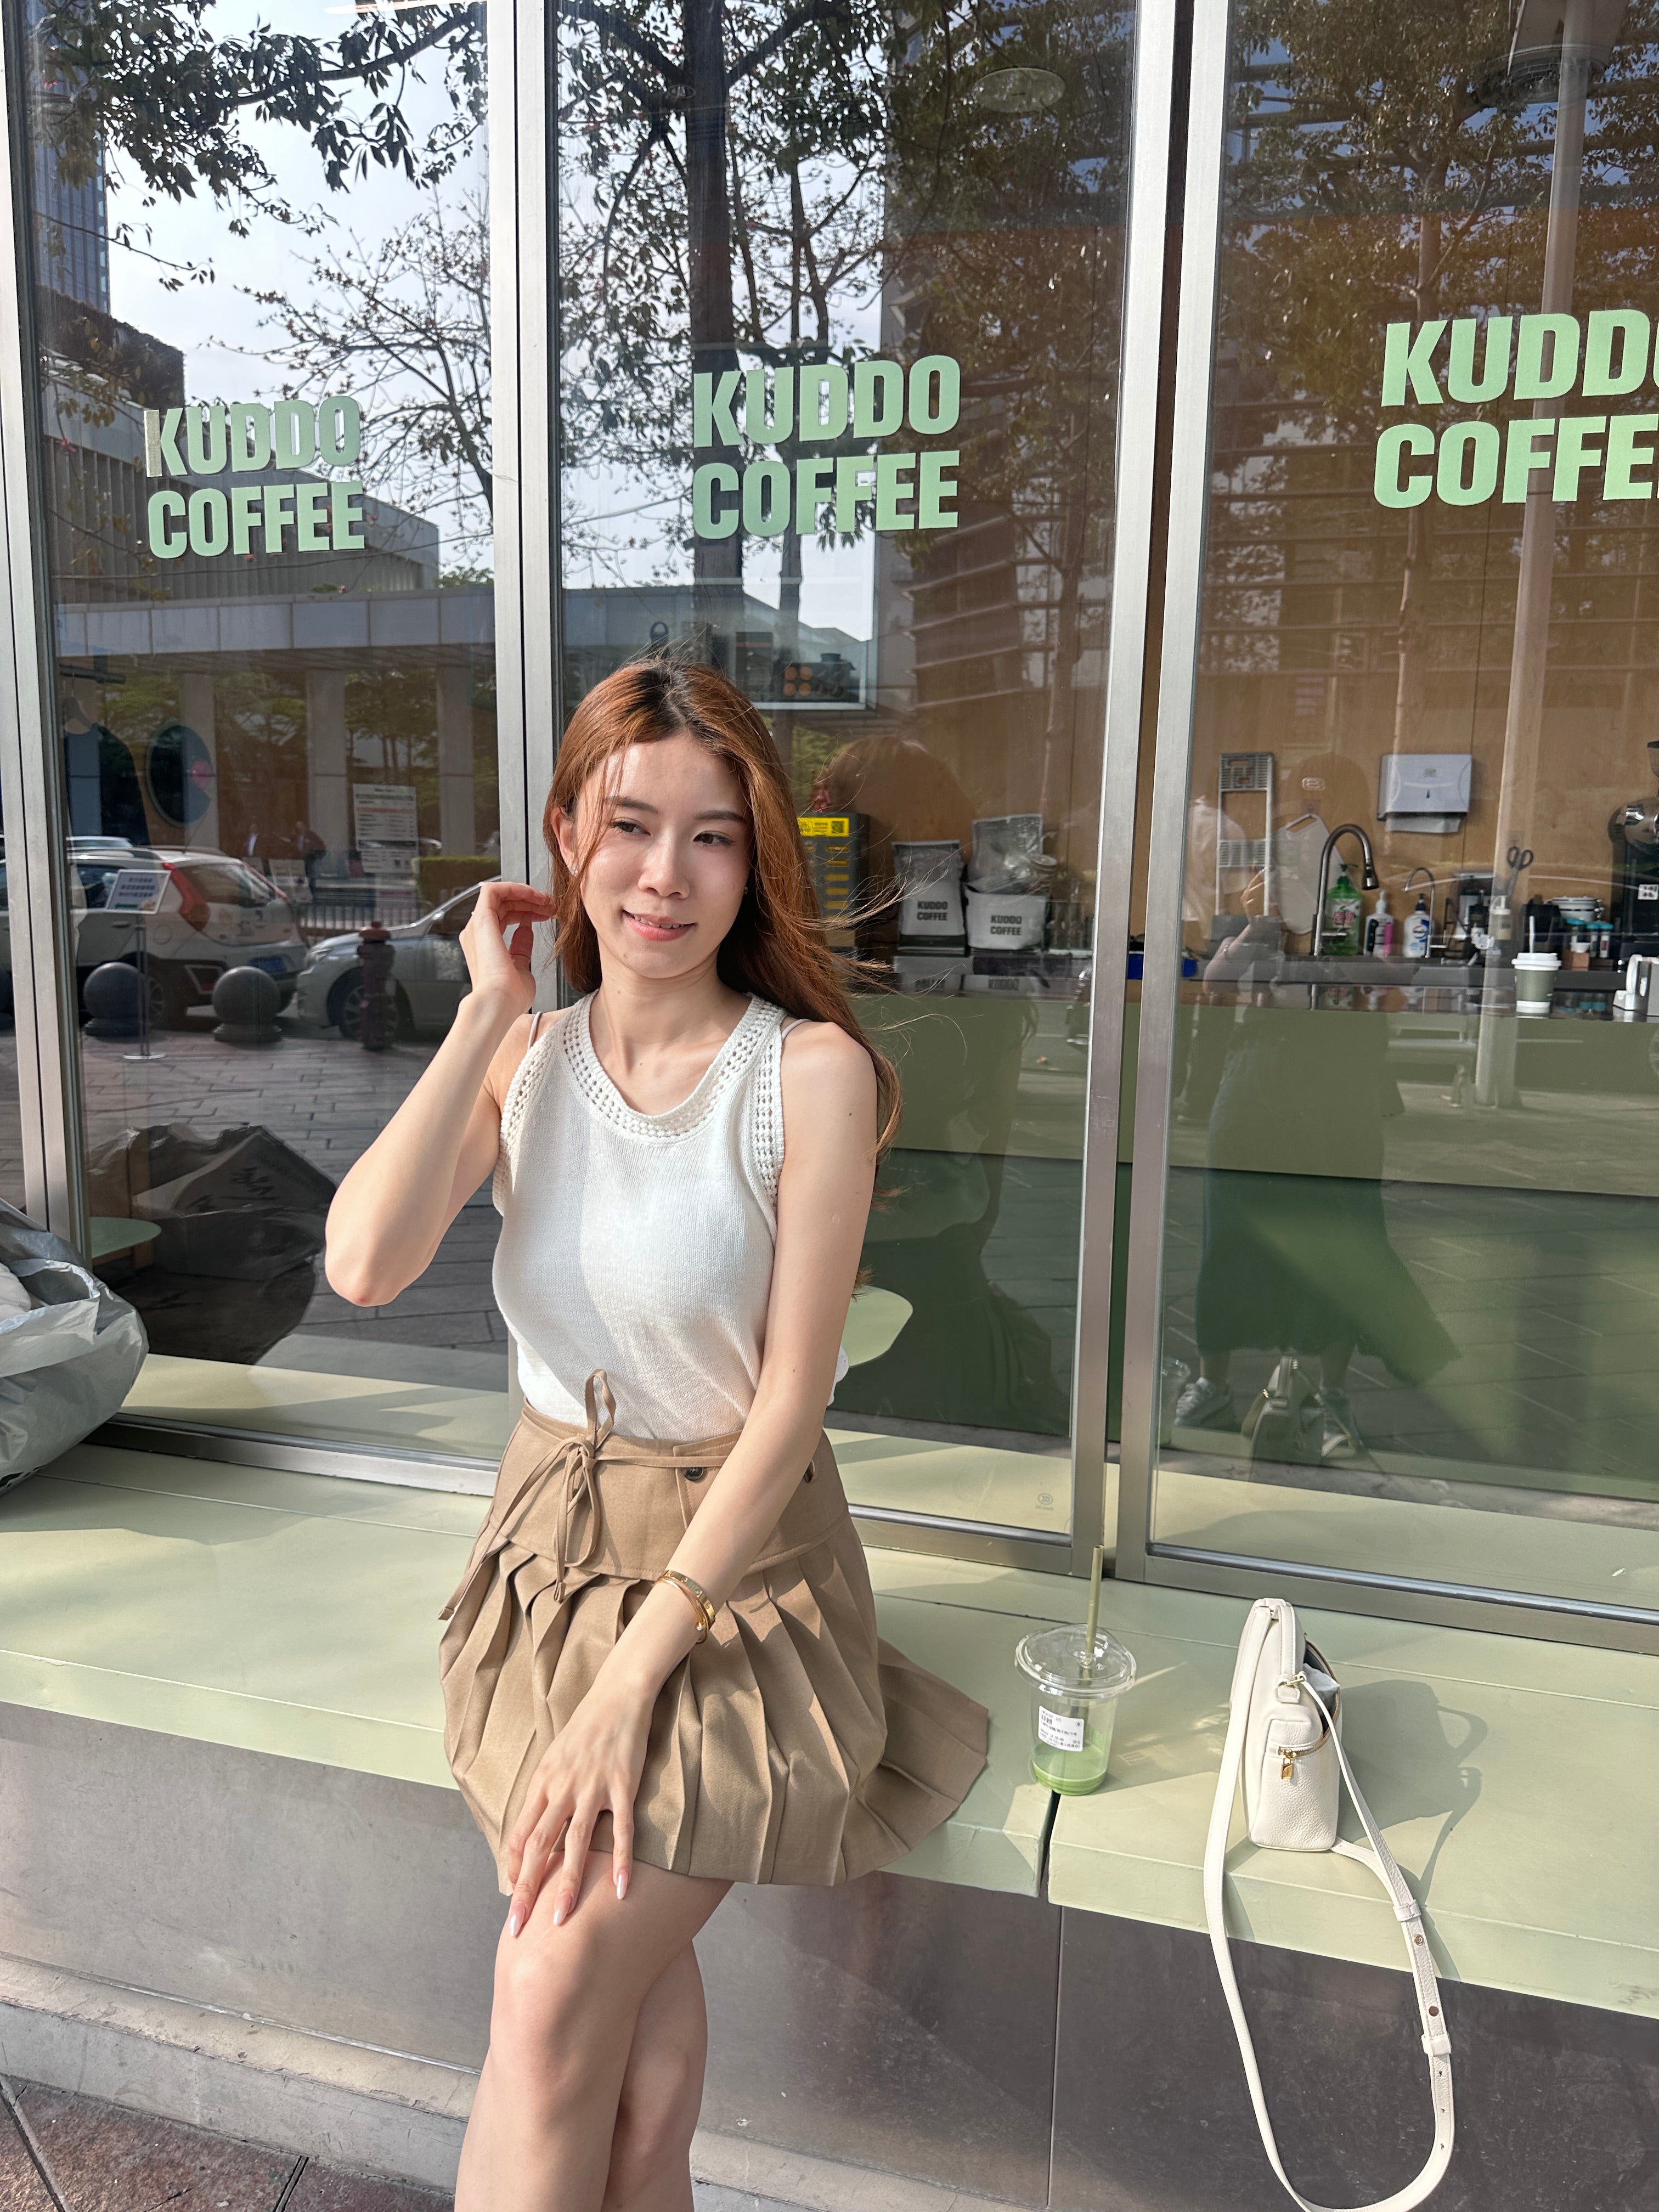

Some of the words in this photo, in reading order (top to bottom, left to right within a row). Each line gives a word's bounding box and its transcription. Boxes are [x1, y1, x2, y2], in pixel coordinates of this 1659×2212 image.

[1381, 309, 1659, 407] KUDD
[143, 396, 362, 478] KUDDO
[692, 354, 961, 448] KUDDO
[692, 450, 960, 539] COFFEE
[1373, 414, 1659, 509] COFFE
[147, 481, 365, 560] COFFEE
[917, 901, 948, 910] KUDDO
[917, 912, 947, 921] COFFEE
[990, 915, 1022, 924] KUDDO
[990, 926, 1022, 935] COFFEE
